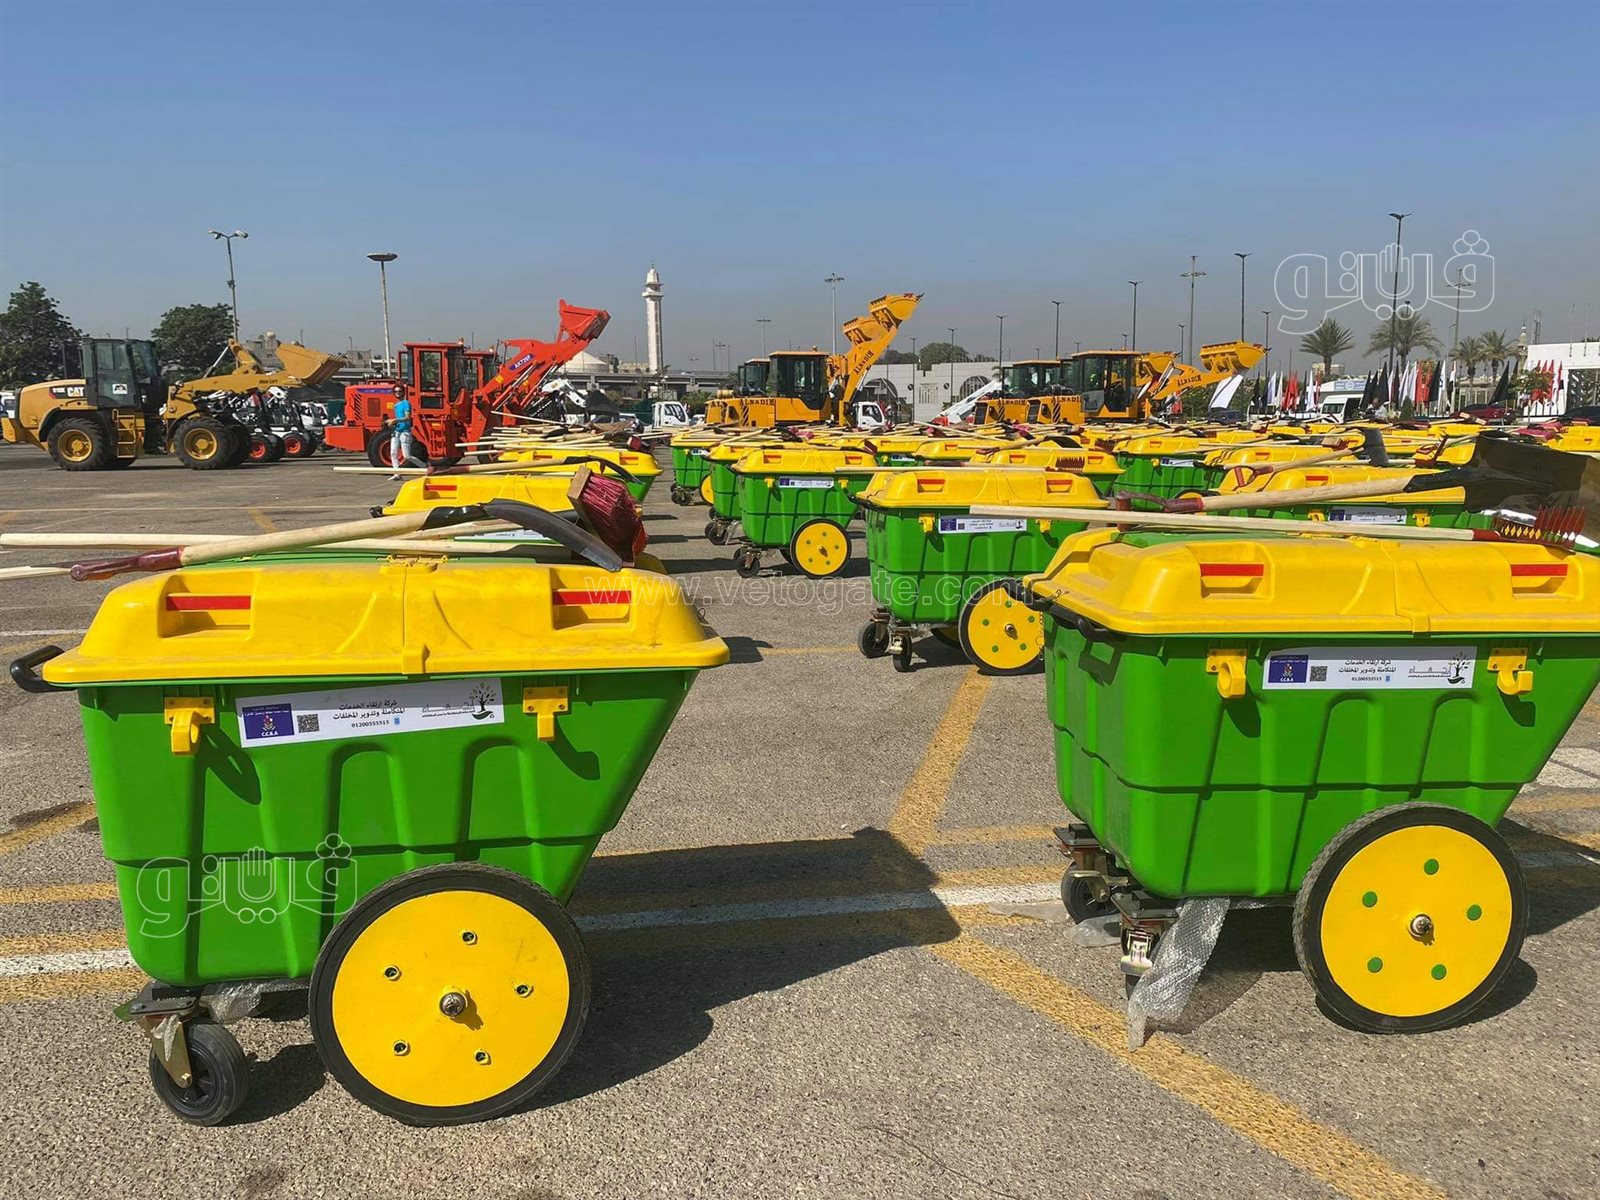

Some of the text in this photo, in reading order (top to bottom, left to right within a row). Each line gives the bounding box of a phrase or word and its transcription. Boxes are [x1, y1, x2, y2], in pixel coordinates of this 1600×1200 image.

[67, 386, 85, 397] CAT
[338, 702, 365, 710] الخدمات
[383, 699, 398, 708] شركة
[332, 707, 405, 719] المتكاملة وتدوير المخلفات
